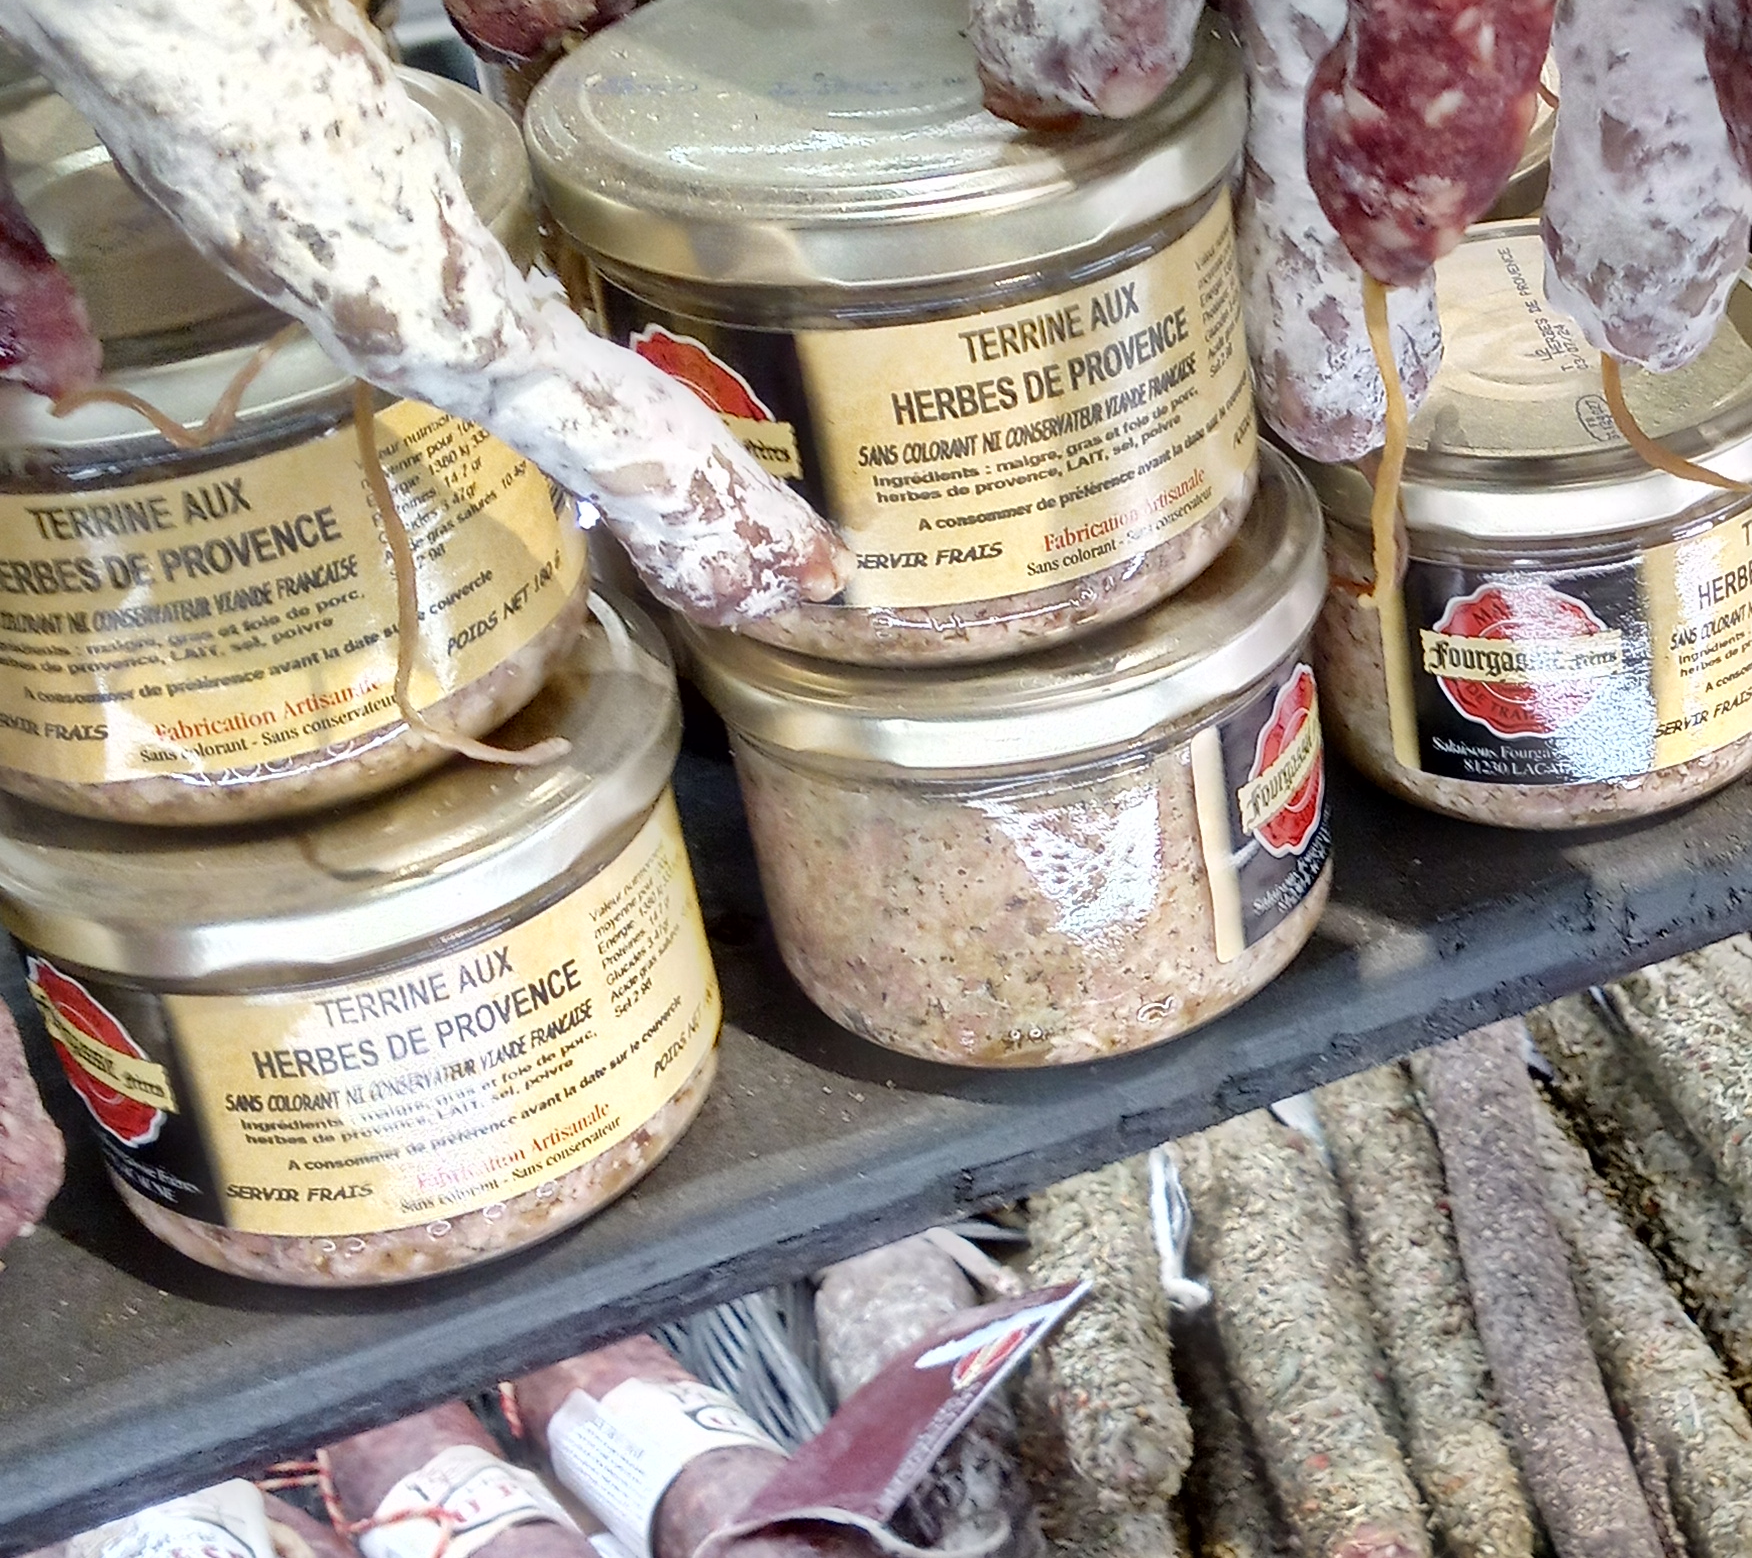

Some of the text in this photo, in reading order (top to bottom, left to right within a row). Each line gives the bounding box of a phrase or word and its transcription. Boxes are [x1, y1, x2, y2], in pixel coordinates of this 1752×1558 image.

[957, 304, 1084, 364] TERRINE
[1090, 281, 1140, 332] AUX
[891, 376, 1018, 426] HERBES
[1022, 364, 1064, 404] DE
[1068, 305, 1189, 391] PROVENCE
[858, 382, 1147, 467] SANS COLORANT NI CONSERVATEUR VIANDE
[872, 467, 980, 489] Ingrédients
[1065, 435, 1103, 457] gras
[1105, 427, 1120, 442] et
[1122, 415, 1150, 437] foie
[876, 489, 942, 504] herbes
[946, 484, 970, 498] de
[975, 467, 1063, 496] provence,
[1141, 414, 1181, 446] poivre
[25, 477, 253, 542] TERRINE AUX
[935, 450, 1172, 530] consommer de préférence avant
[0, 505, 343, 595] ERBES DE PROVENCE
[934, 541, 1004, 566] FRAIS
[1026, 538, 1117, 576] Sans colorant
[429, 568, 494, 621] couvercle
[446, 581, 530, 657] POIDS NET
[269, 651, 323, 678] avant
[1669, 627, 1698, 651] SANS
[45, 722, 109, 742] FRAIS
[140, 749, 178, 763] Sans
[261, 726, 299, 746] Sans
[155, 709, 277, 743] Fabrication
[1655, 706, 1709, 739] SERVIR
[315, 945, 514, 1028] TERRINE AUX
[252, 959, 582, 1080] HERBES DE PROVENCE
[225, 1093, 263, 1113] SANS
[267, 1090, 340, 1113] COLORANT
[530, 998, 593, 1050] FRANCAISE
[520, 1092, 562, 1119] avant
[564, 1084, 577, 1099] la
[580, 1065, 606, 1090] date
[609, 1049, 629, 1070] sur
[524, 1057, 574, 1091] poivre
[531, 1101, 611, 1154] Artisanale
[226, 1183, 374, 1202] SERVIR FRAIS
[511, 1160, 544, 1183] Sans
